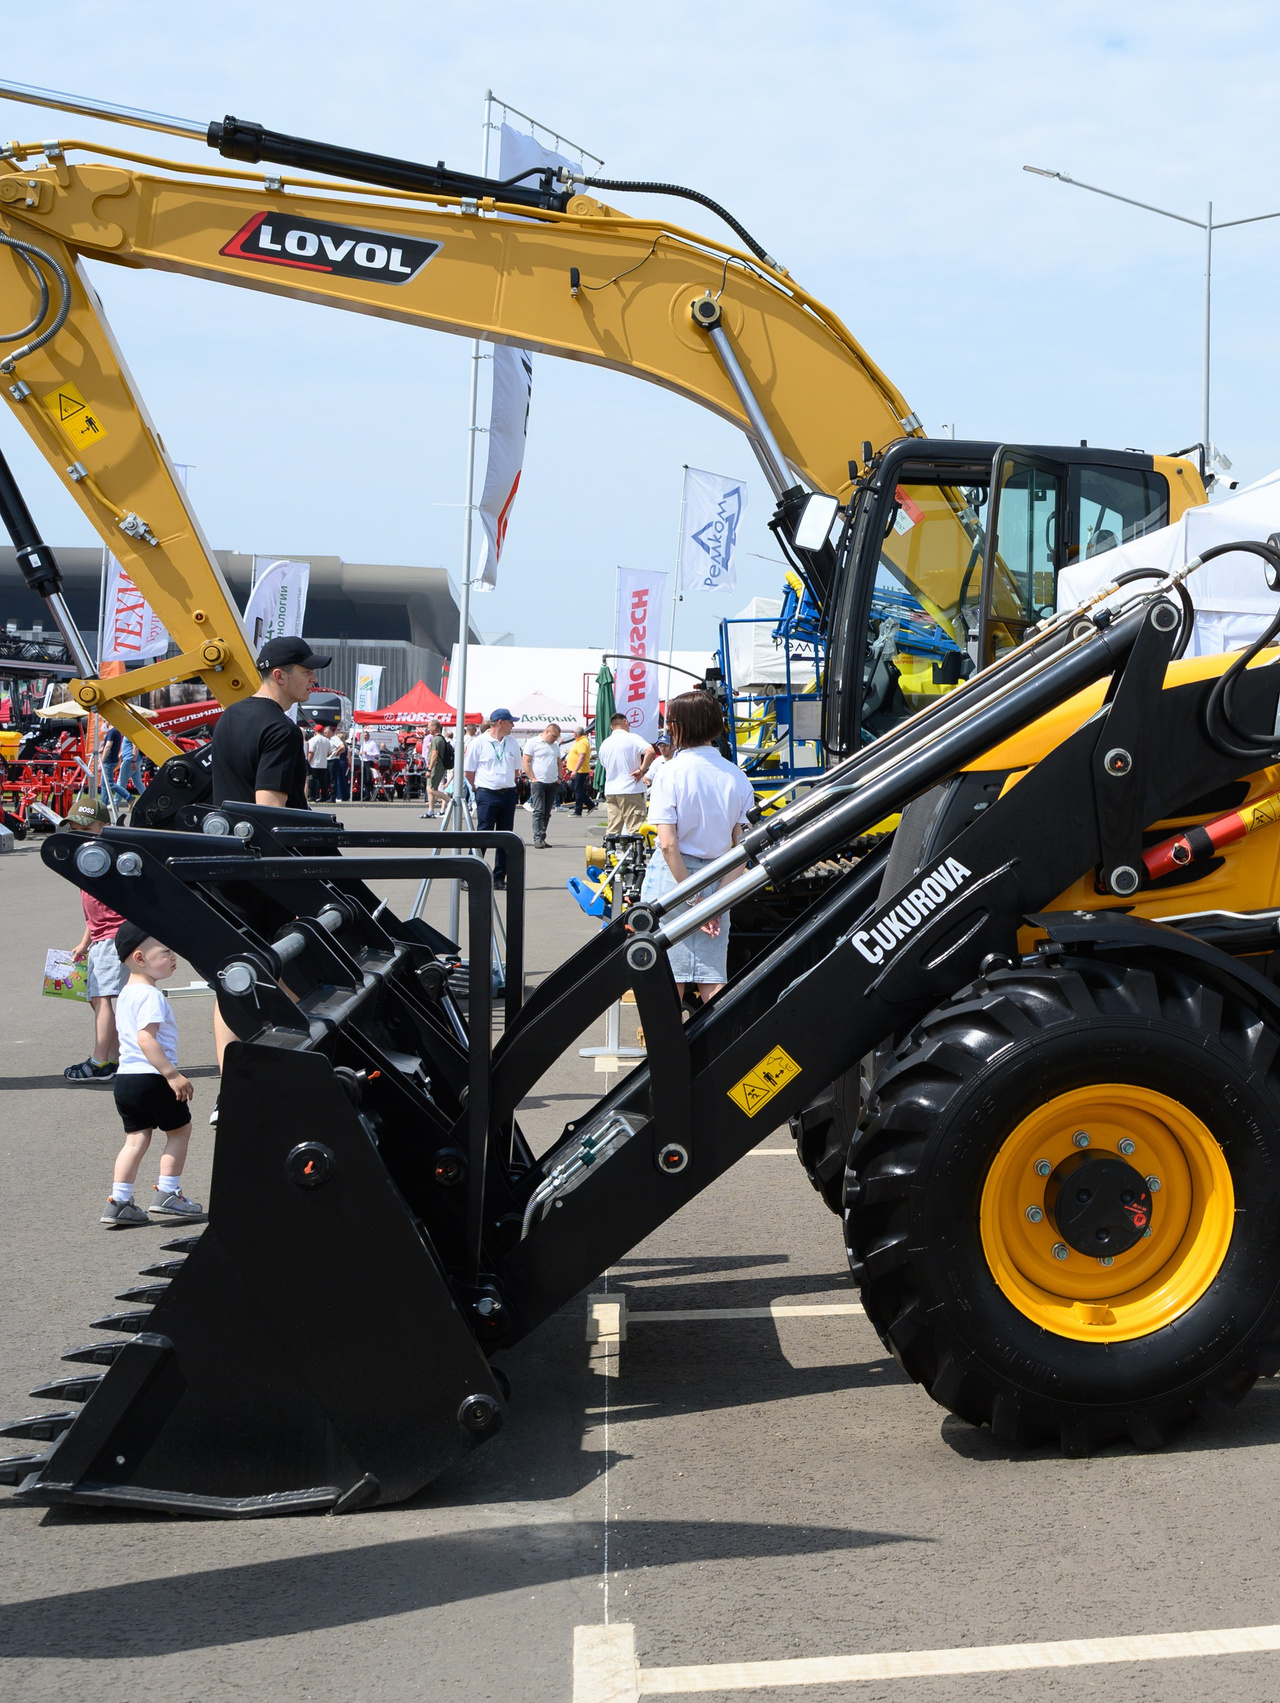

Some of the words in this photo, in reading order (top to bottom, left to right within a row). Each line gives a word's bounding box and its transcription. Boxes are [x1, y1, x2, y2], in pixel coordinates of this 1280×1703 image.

[258, 224, 412, 275] LOVOL
[277, 585, 288, 639] НОЛОГИИ
[396, 712, 453, 723] HORSCH
[521, 713, 577, 724] Добрый
[78, 805, 95, 815] BOSS
[851, 856, 973, 966] ÇUKUROVA
